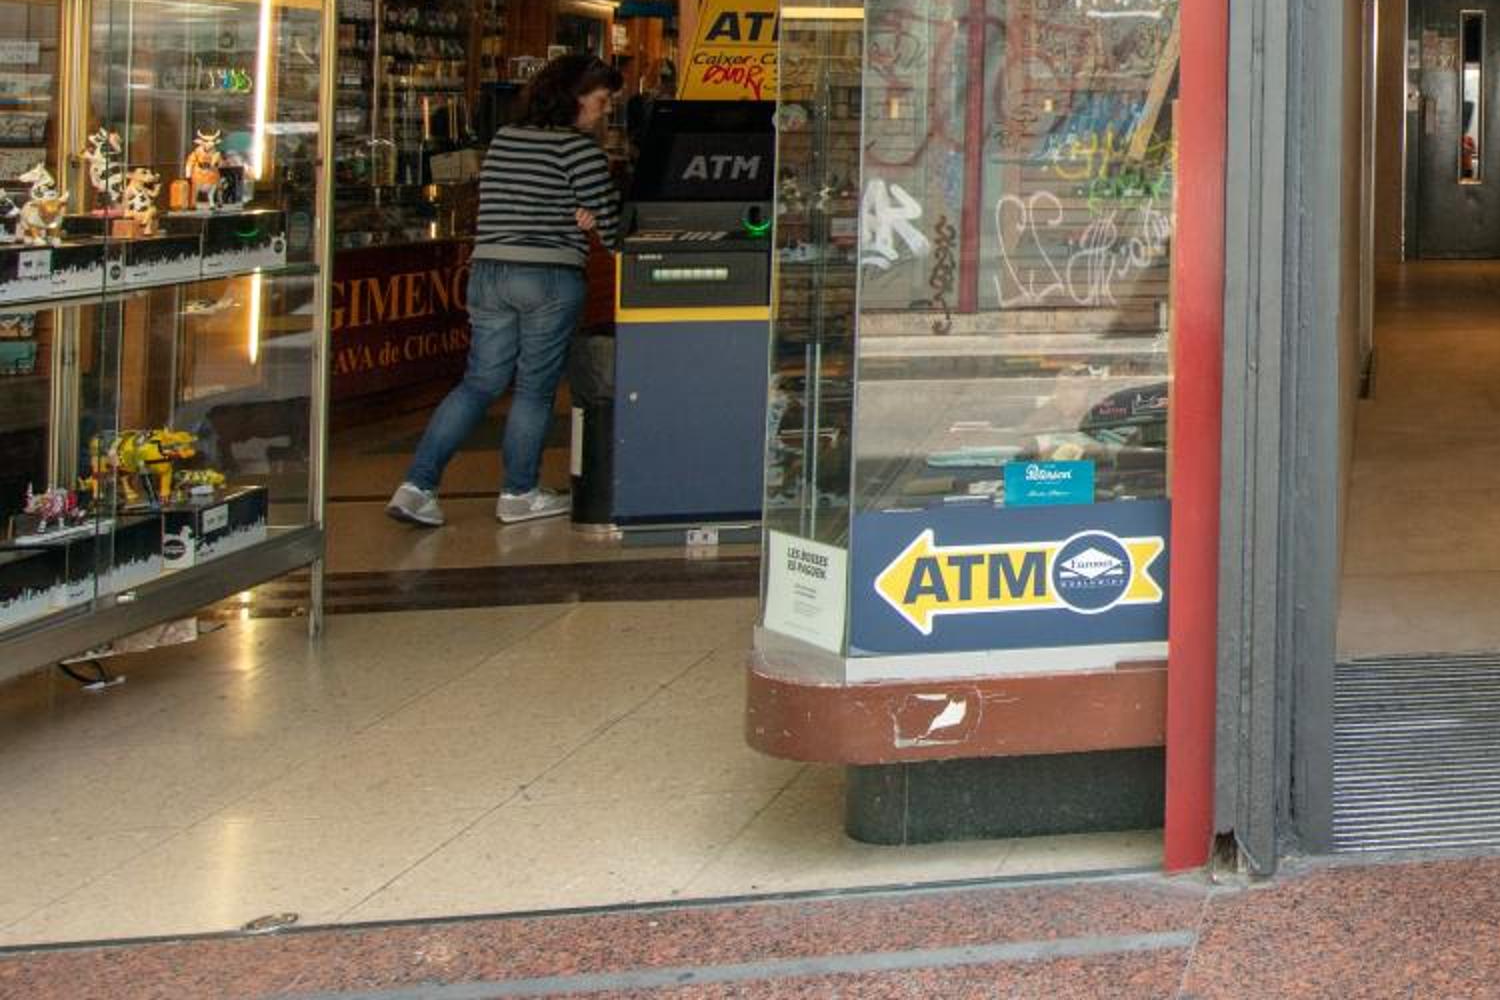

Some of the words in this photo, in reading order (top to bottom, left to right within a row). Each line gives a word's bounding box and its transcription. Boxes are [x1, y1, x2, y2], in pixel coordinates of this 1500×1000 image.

[704, 10, 779, 42] AT
[681, 155, 761, 181] ATM
[333, 343, 374, 375] AVA
[903, 550, 1047, 606] ATM
